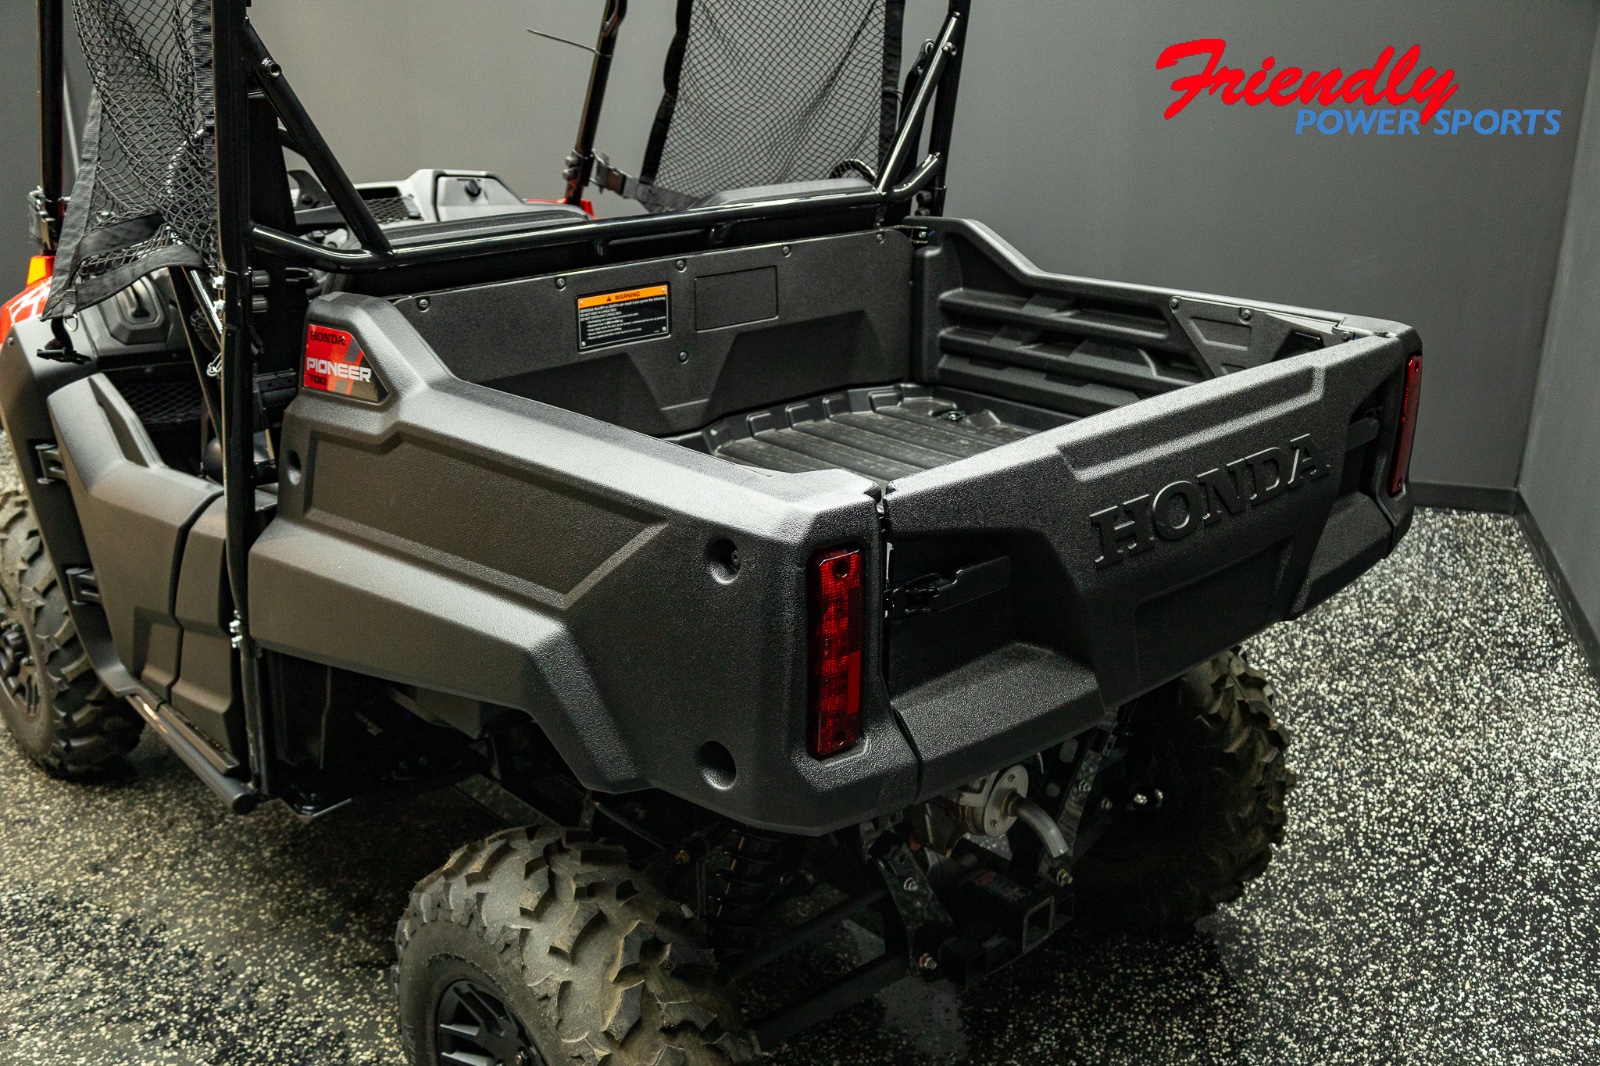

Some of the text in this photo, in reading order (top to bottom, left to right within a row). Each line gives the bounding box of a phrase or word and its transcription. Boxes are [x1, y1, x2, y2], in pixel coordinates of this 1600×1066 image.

[615, 291, 641, 300] WARNING
[309, 330, 346, 346] HONDA
[306, 357, 372, 383] PIONEER
[308, 373, 327, 386] 700
[1089, 433, 1331, 570] HONDA
